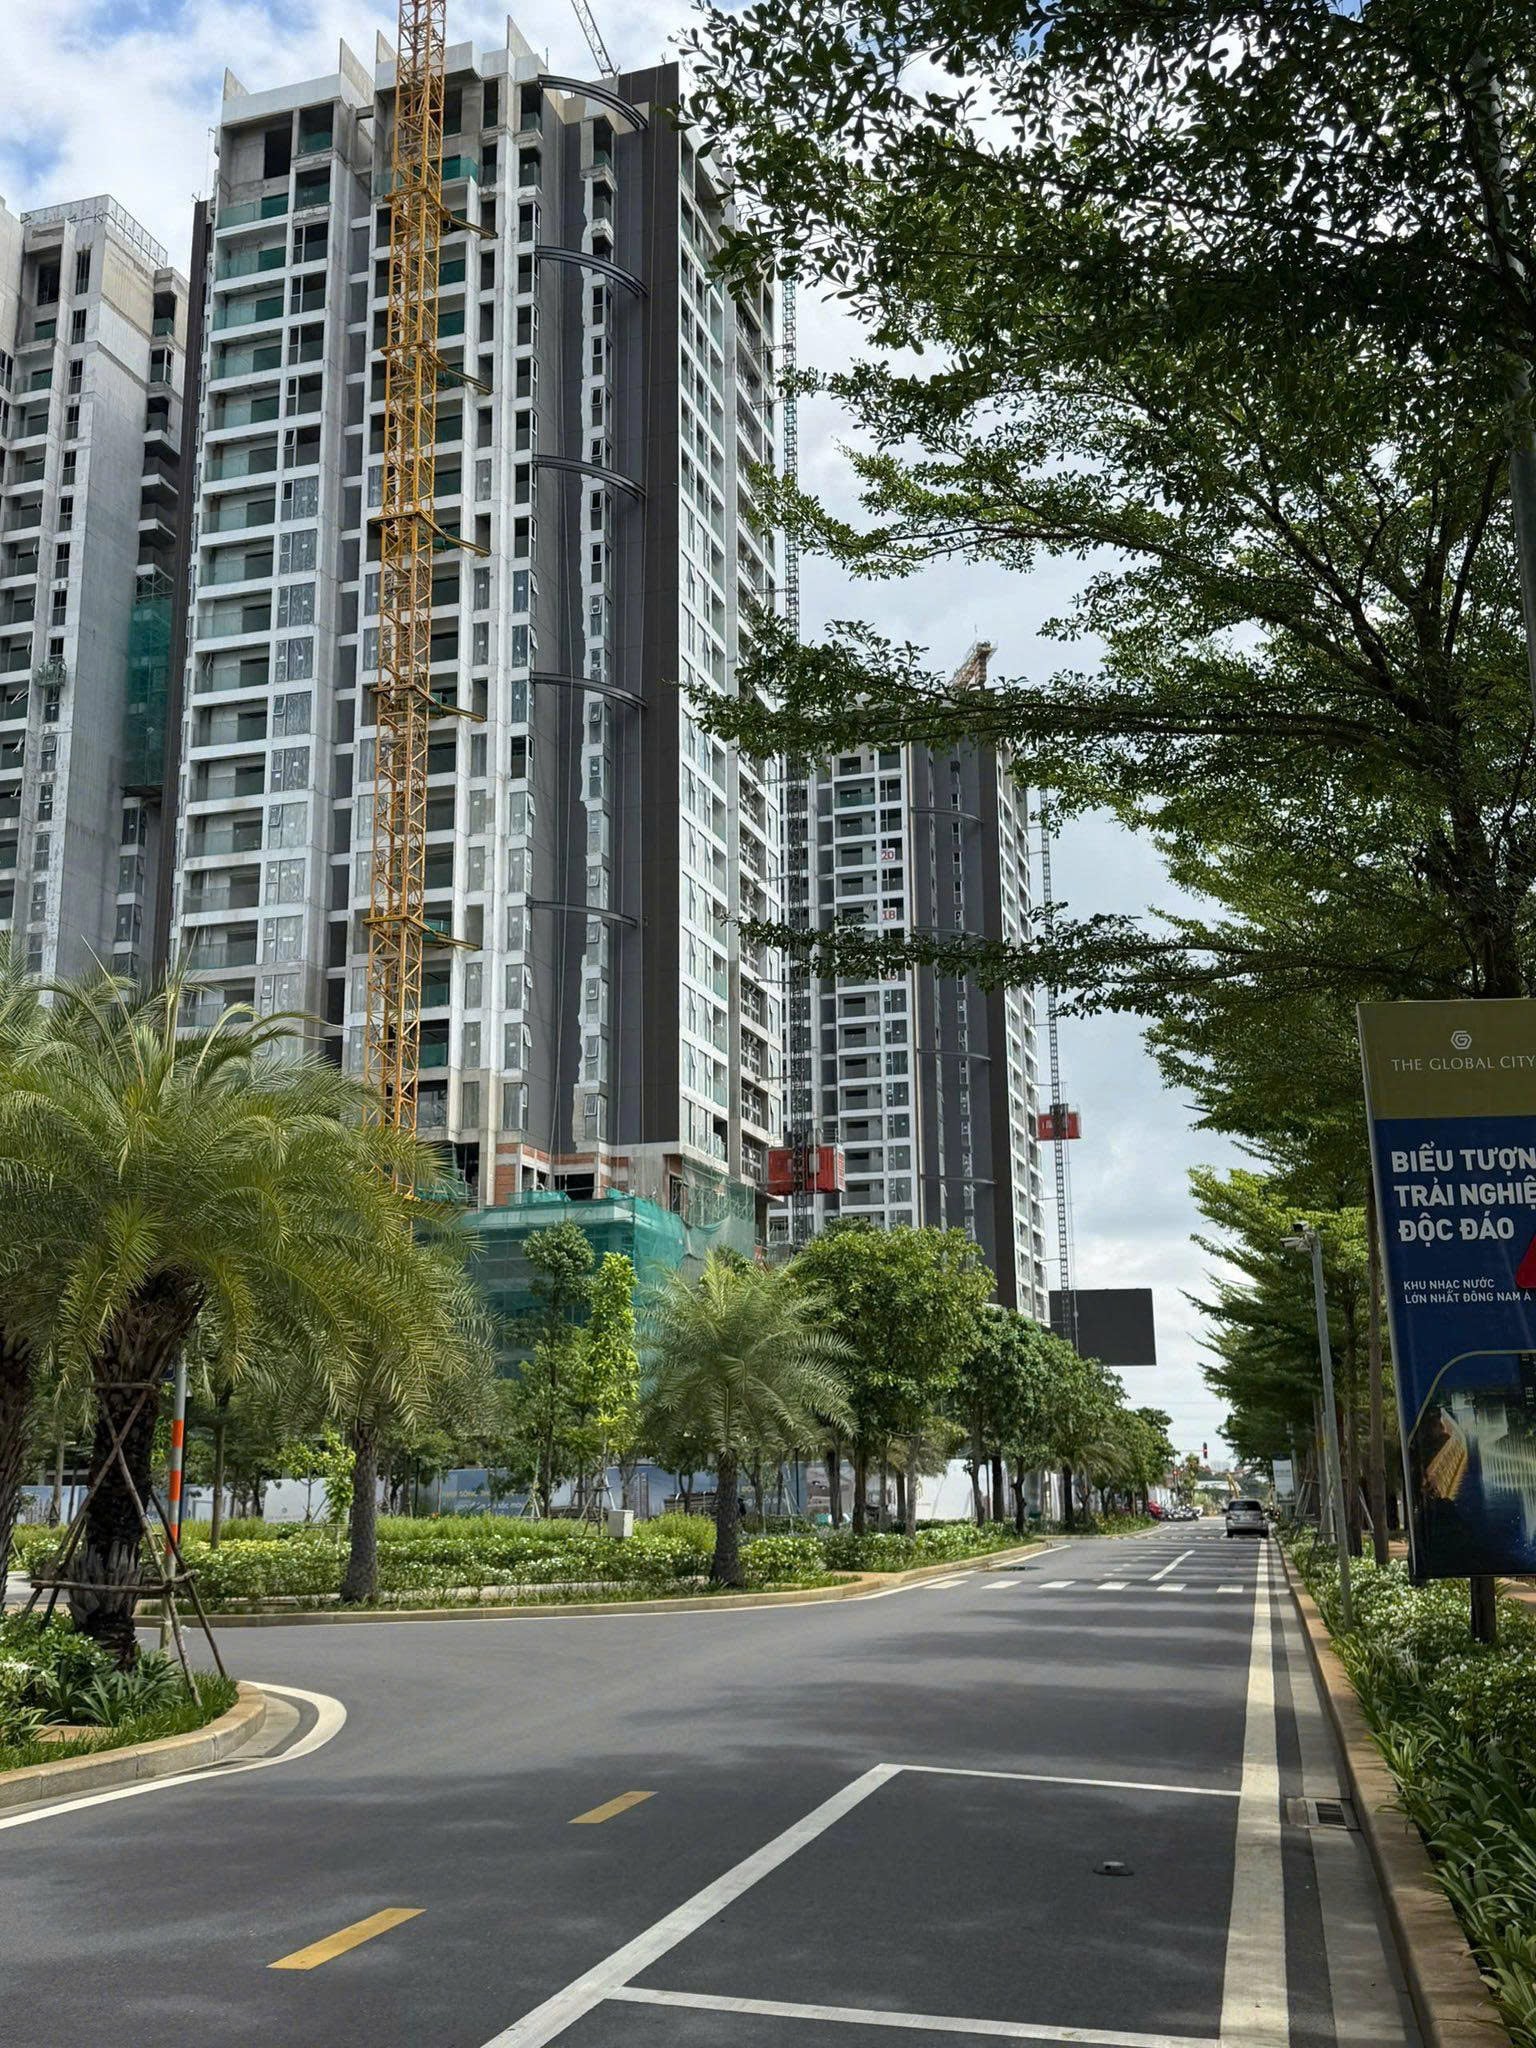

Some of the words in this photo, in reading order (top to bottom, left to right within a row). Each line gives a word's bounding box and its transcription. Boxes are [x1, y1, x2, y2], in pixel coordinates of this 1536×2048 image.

[881, 850, 894, 860] 20
[882, 910, 896, 920] 18
[1391, 1058, 1423, 1072] THE
[1429, 1056, 1495, 1071] GLOBAL
[1500, 1055, 1536, 1069] CITY
[1391, 1141, 1454, 1173] BIỂU
[1393, 1177, 1455, 1207] TRẢI
[1398, 1212, 1454, 1248] ĐỘC
[1459, 1211, 1515, 1241] ĐÁO
[1403, 1280, 1427, 1290] KHU
[1462, 1276, 1495, 1289] NƯỚC
[1404, 1291, 1427, 1304] LỚN
[1497, 1291, 1521, 1302] NAM
